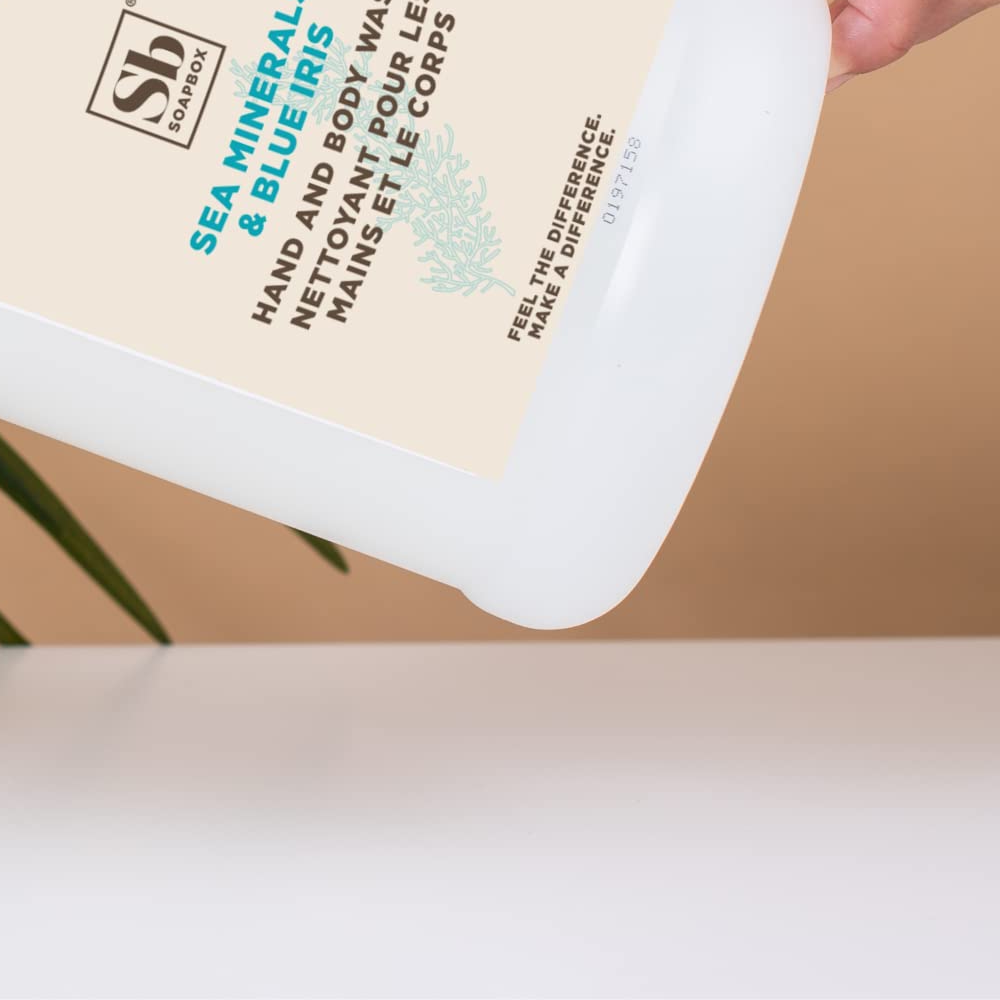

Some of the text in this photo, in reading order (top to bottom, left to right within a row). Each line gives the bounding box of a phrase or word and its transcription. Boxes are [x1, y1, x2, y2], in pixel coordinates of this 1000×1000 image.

[112, 35, 185, 124] Sb
[168, 47, 208, 133] SOAPBOX
[238, 22, 334, 237] & BLUE IRIS
[326, 11, 456, 324] MAINS ET LE CORPS
[601, 135, 643, 226] 0197158
[189, 185, 241, 256] SEA
[251, 238, 304, 325] HAND
[295, 162, 334, 231] AND
[322, 64, 368, 153] BODY
[290, 145, 380, 331] NETTOYANT
[367, 51, 414, 139] POUR
[507, 114, 602, 342] FEEL THE DIFFERENCE.
[527, 129, 616, 340] MAKE A DIFFERENCE.
